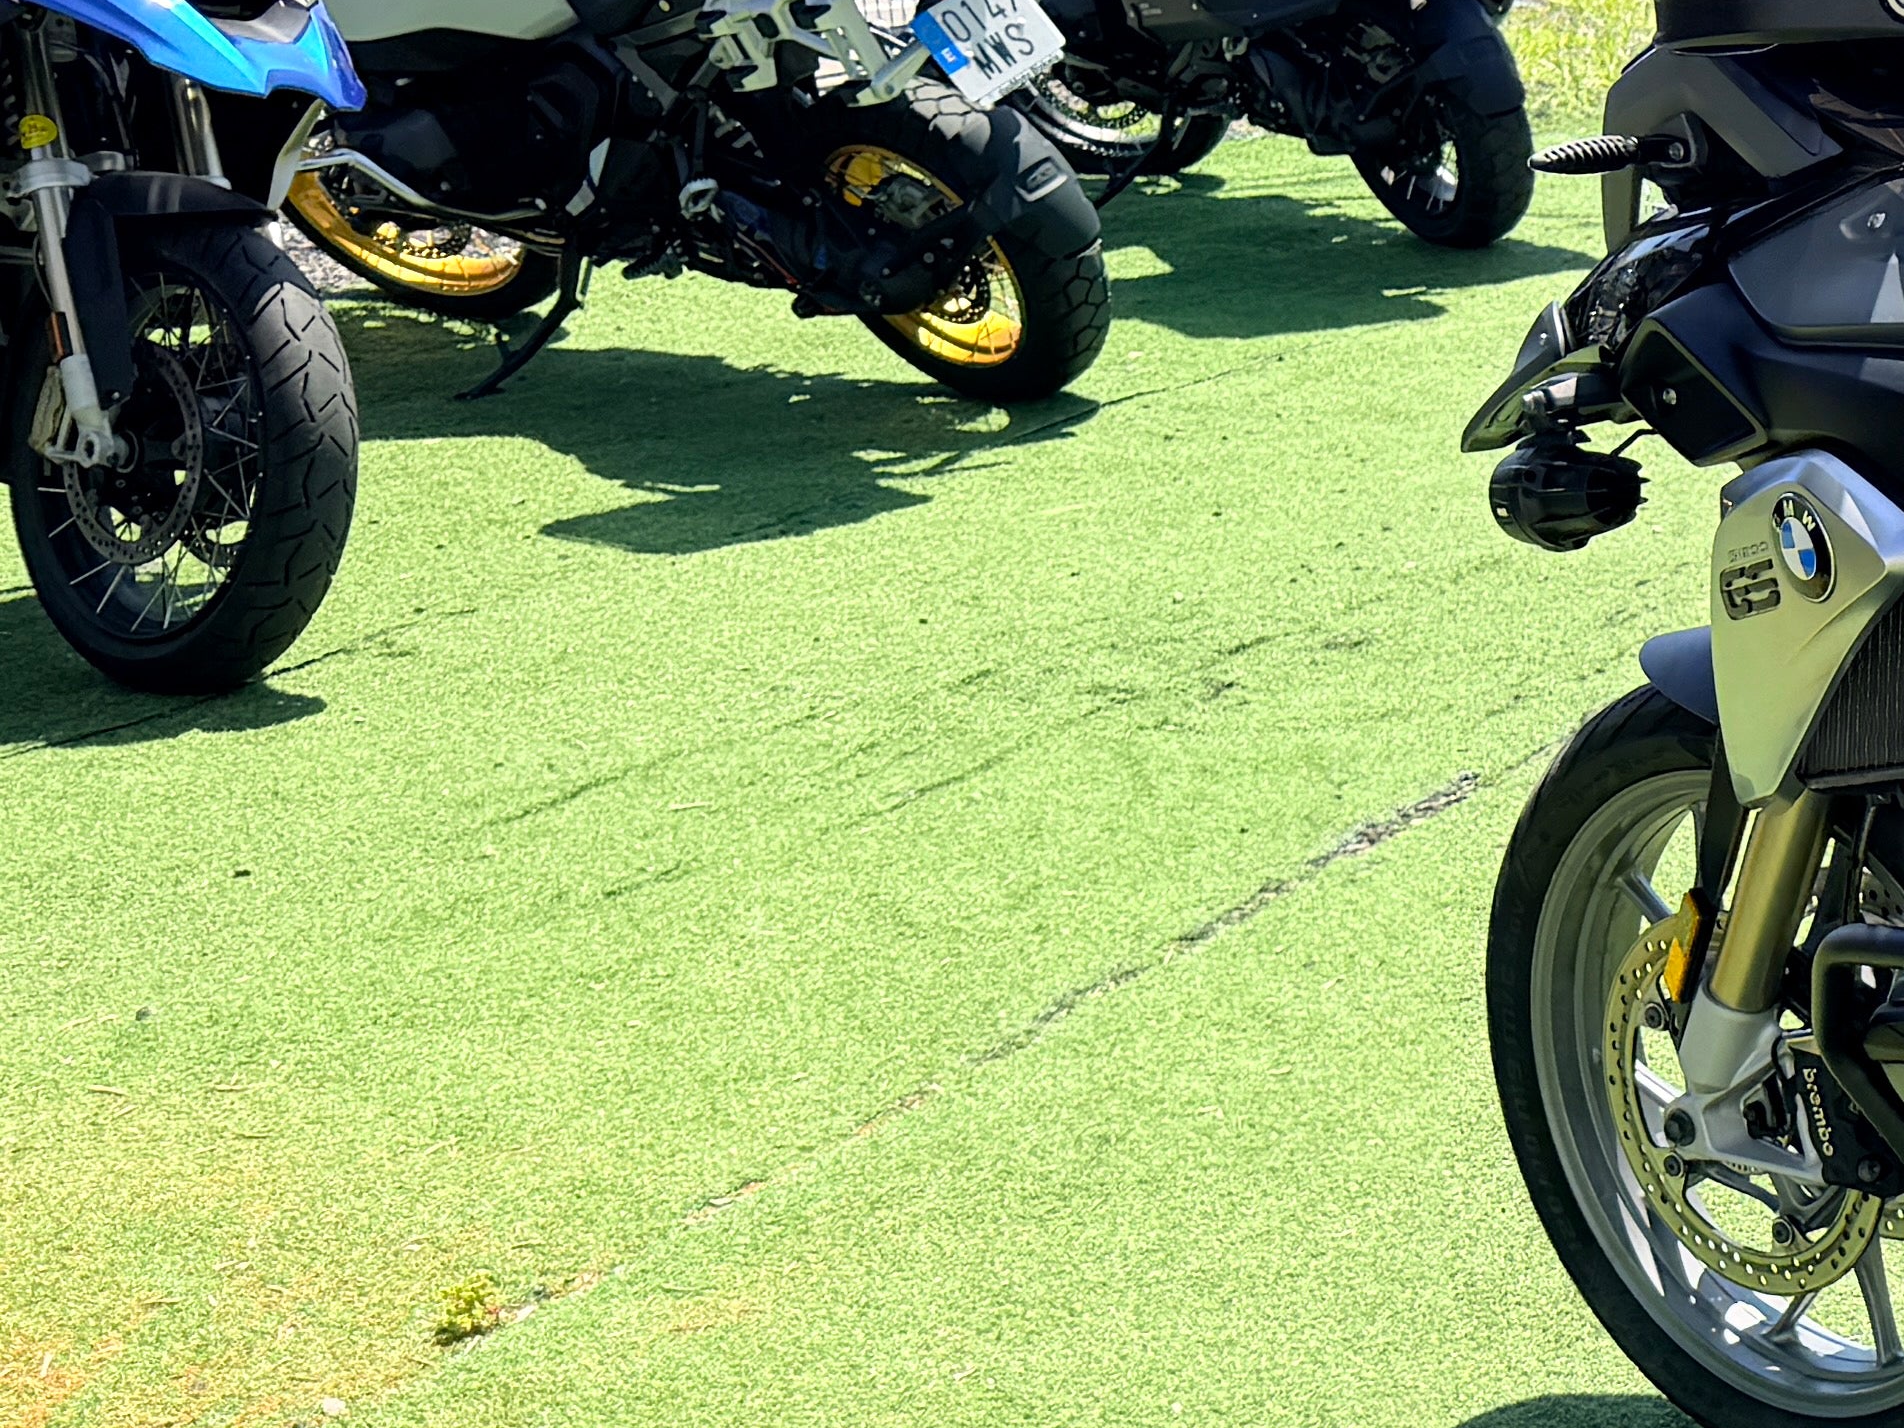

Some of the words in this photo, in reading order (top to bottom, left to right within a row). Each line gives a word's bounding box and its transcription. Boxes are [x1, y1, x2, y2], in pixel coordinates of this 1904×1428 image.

[941, 47, 959, 64] E
[972, 23, 1035, 81] MWS
[1719, 558, 1782, 621] GS
[1802, 1067, 1835, 1158] brembo
